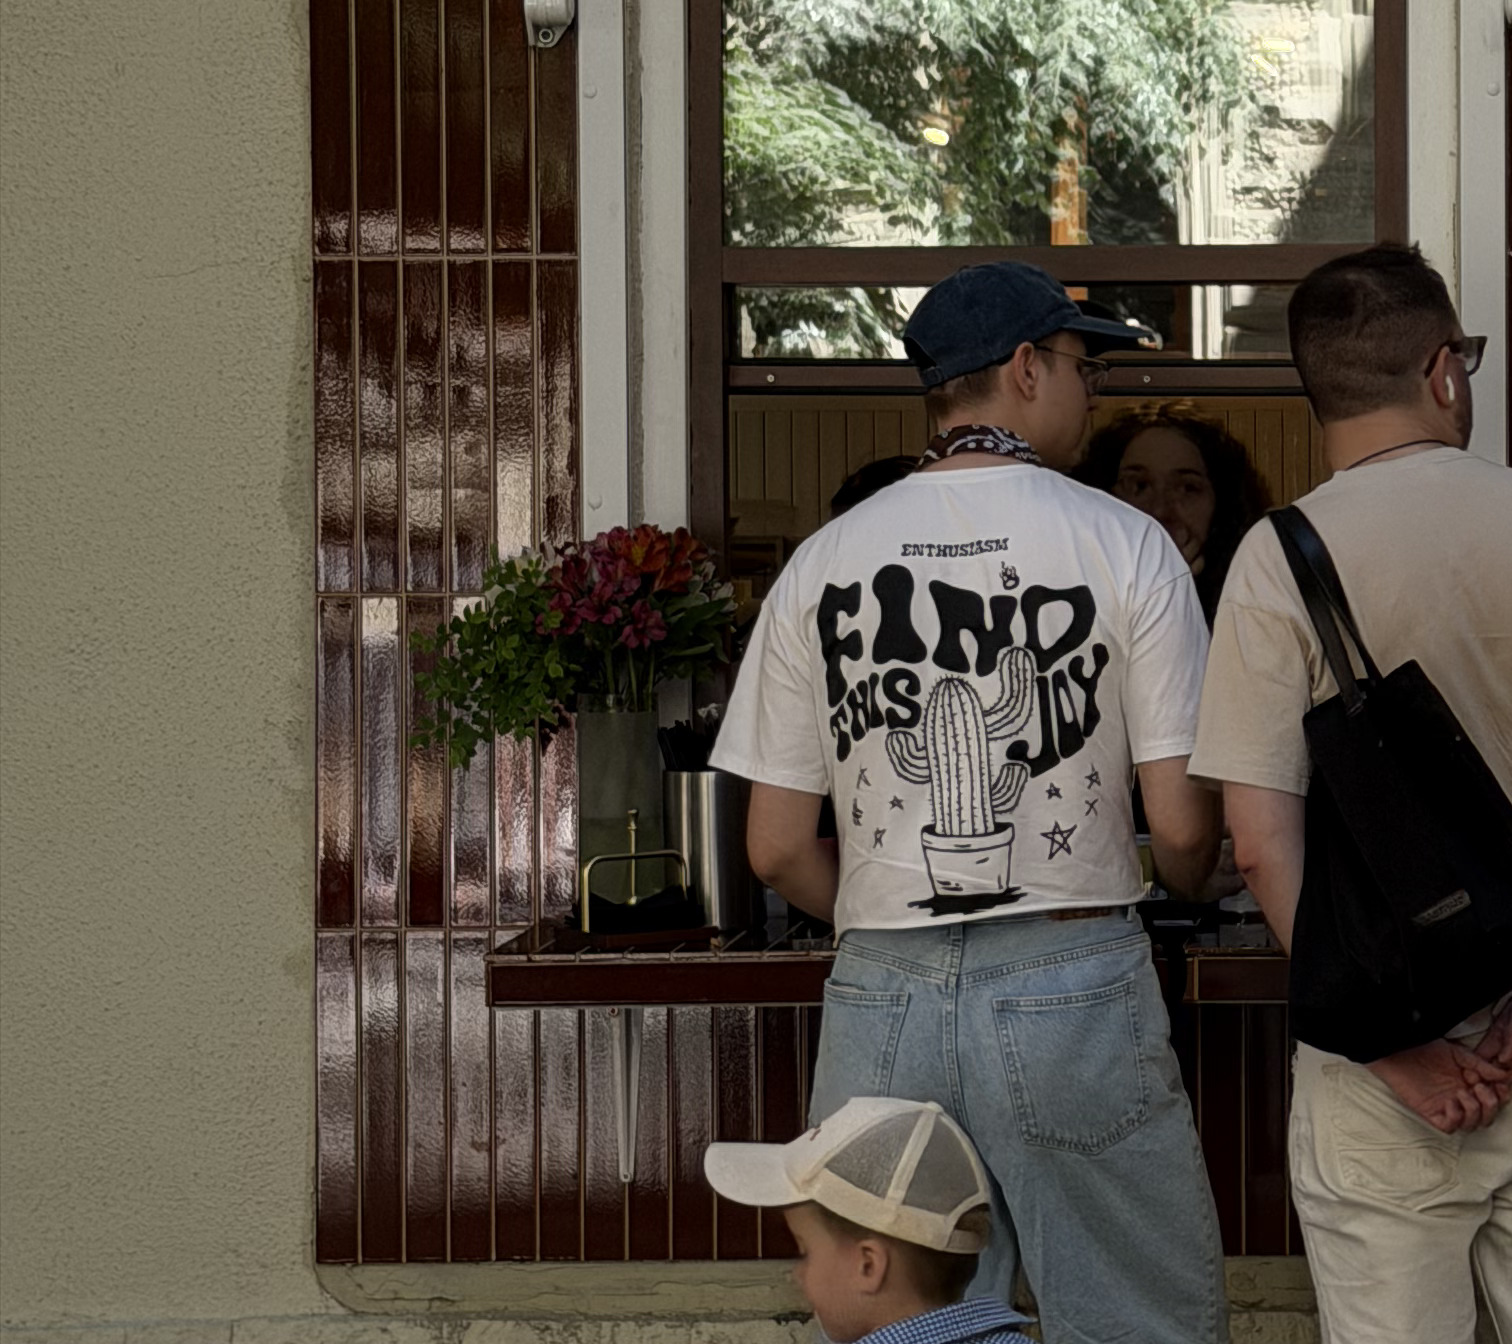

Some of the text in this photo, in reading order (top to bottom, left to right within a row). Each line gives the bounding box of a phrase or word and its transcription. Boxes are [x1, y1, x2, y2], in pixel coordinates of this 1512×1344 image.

[901, 537, 1010, 558] ENTHUSIASM
[816, 563, 1097, 708] FIND
[829, 642, 1111, 778] THIS JOY
